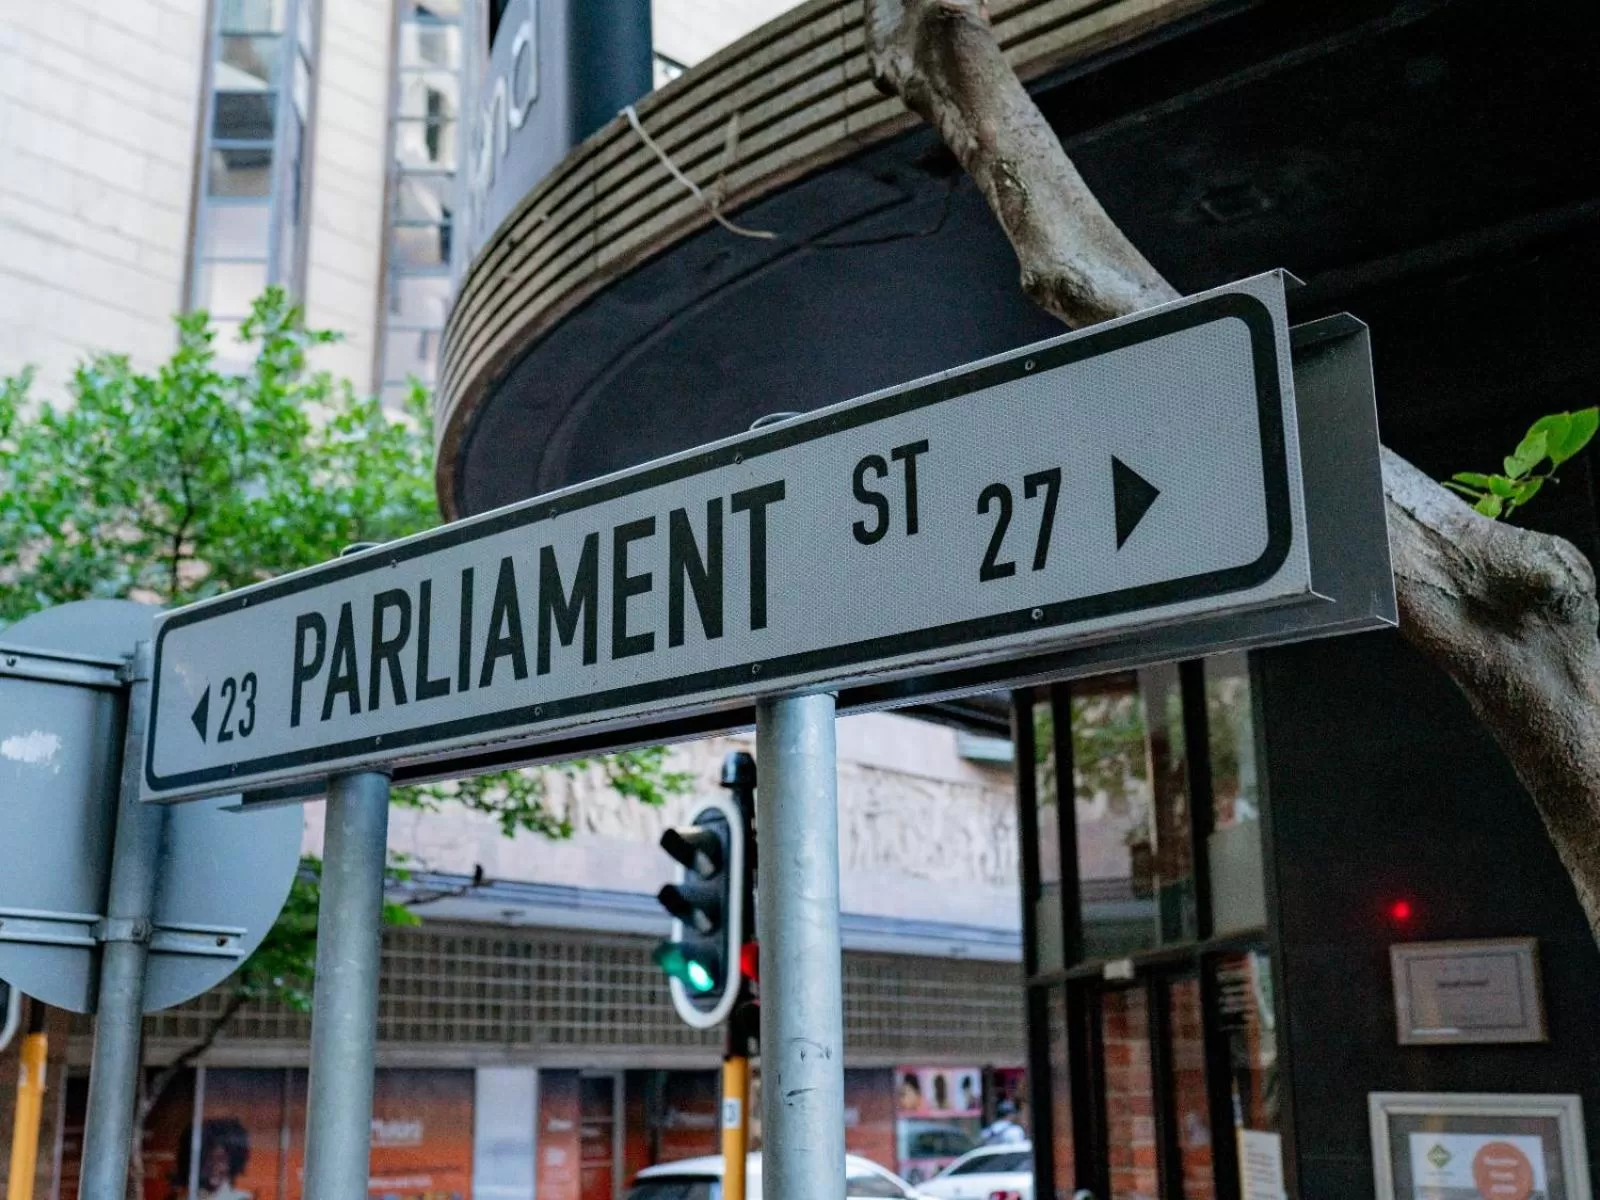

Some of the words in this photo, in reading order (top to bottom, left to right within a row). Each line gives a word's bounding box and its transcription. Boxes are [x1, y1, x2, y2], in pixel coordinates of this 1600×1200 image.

[290, 478, 785, 728] PARLIAMENT
[852, 438, 930, 545] ST
[976, 468, 1062, 583] 27
[218, 671, 258, 744] 23
